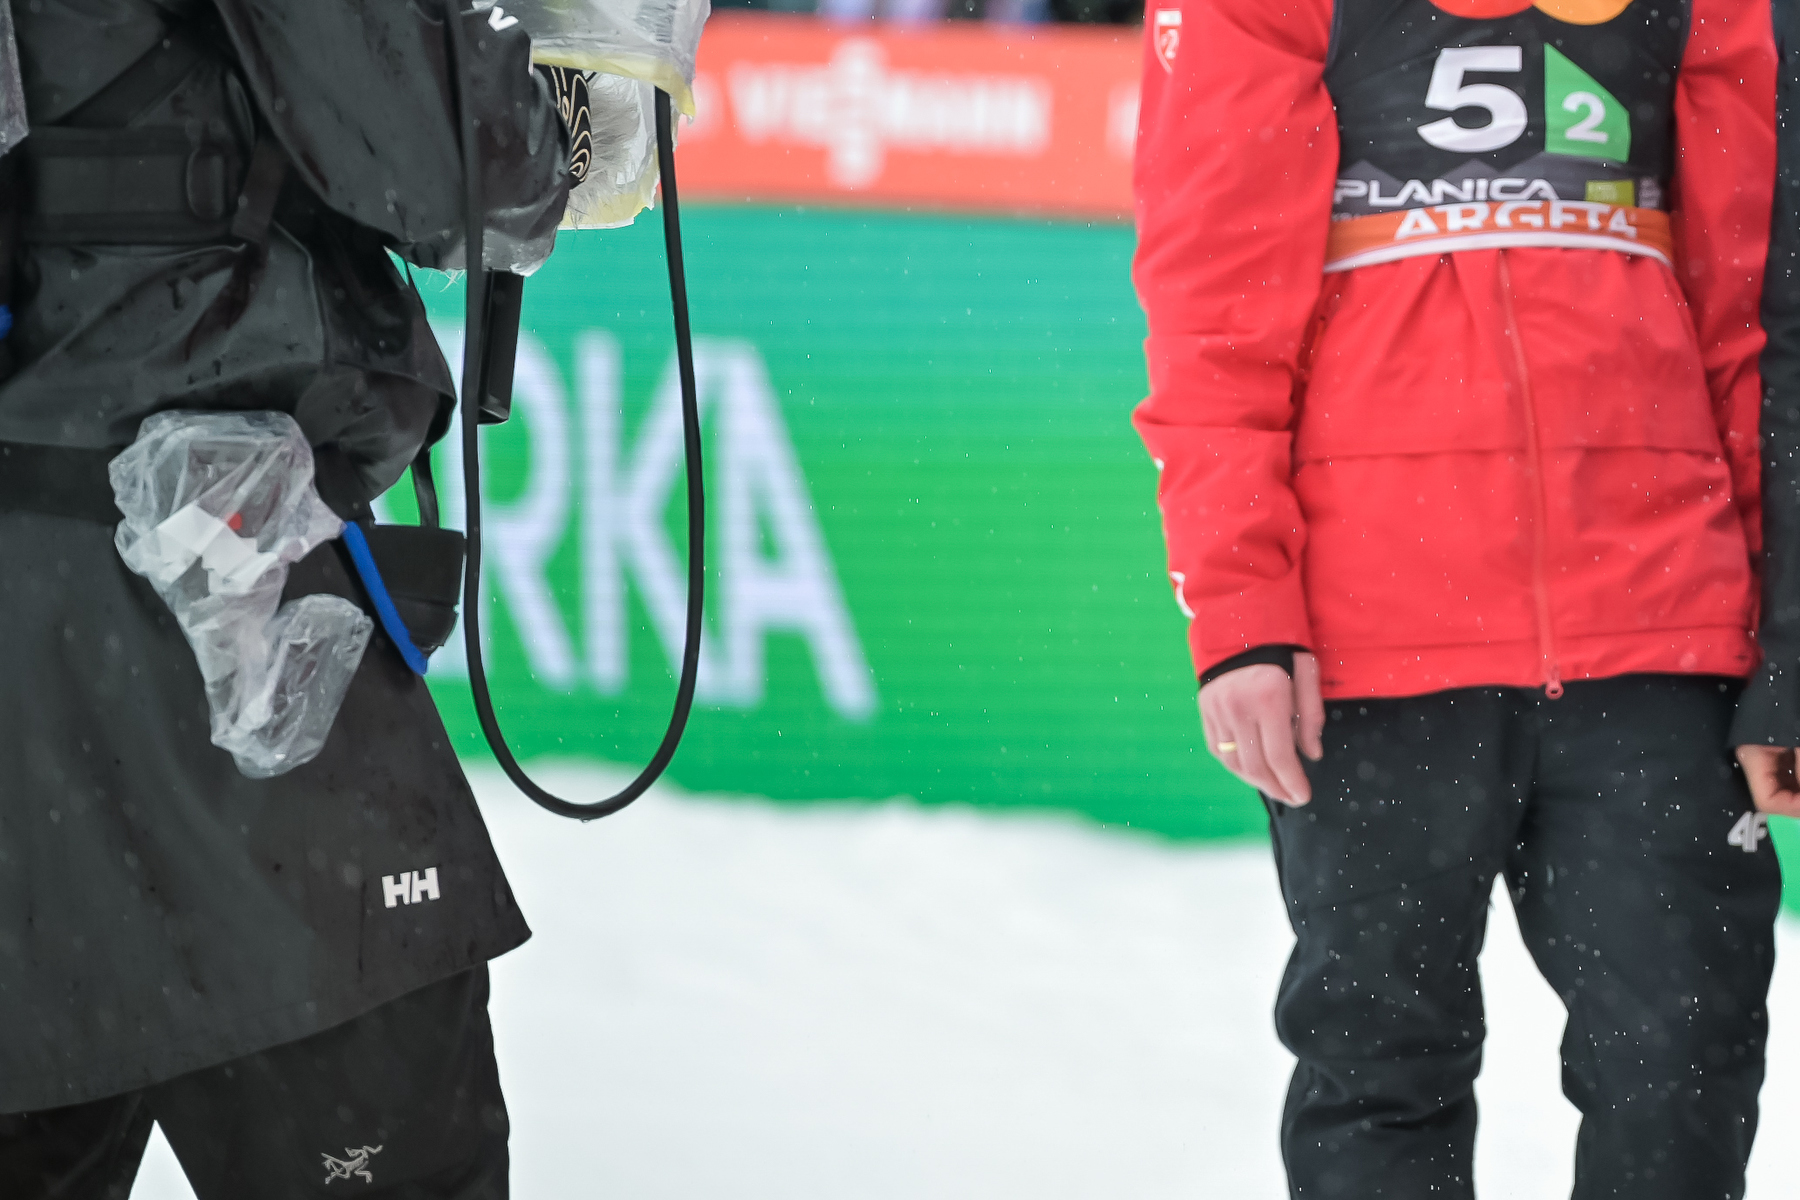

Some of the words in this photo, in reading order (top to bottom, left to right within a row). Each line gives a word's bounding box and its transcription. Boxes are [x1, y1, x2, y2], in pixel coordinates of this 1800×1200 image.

[1417, 45, 1528, 152] 5
[1561, 92, 1608, 142] 2
[1332, 177, 1560, 207] PLANICA
[428, 324, 876, 720] RKA
[382, 867, 440, 908] HH
